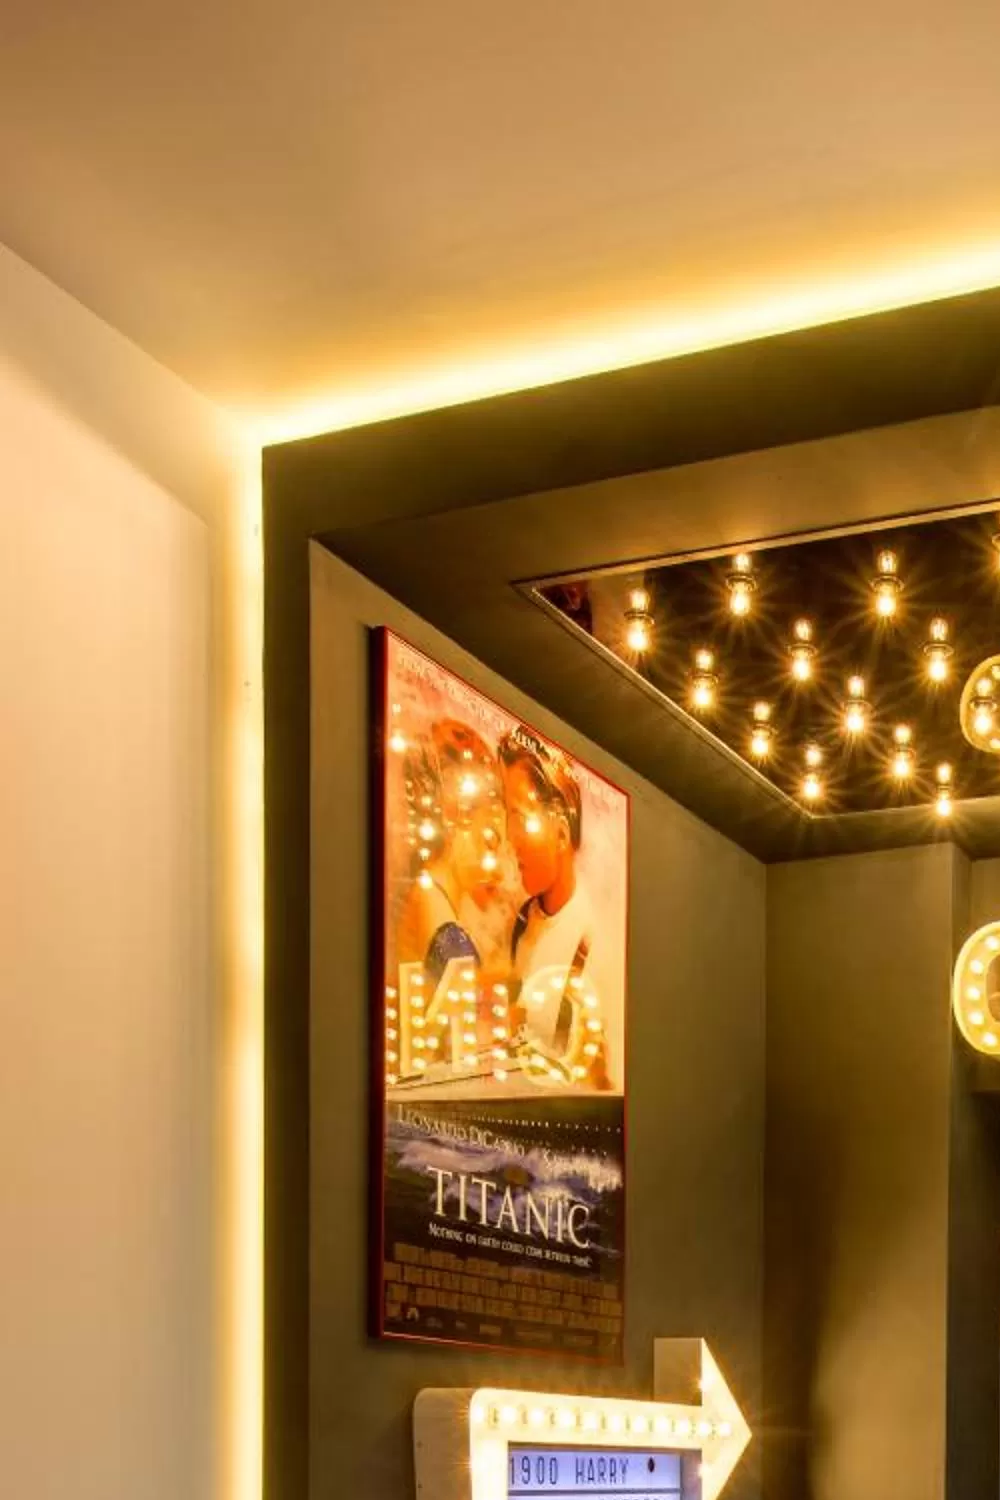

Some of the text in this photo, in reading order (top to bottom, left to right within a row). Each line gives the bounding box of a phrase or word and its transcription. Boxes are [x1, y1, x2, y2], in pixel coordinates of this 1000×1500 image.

[426, 1165, 590, 1249] TITANIC
[509, 1455, 629, 1485] 1900 HARRY
